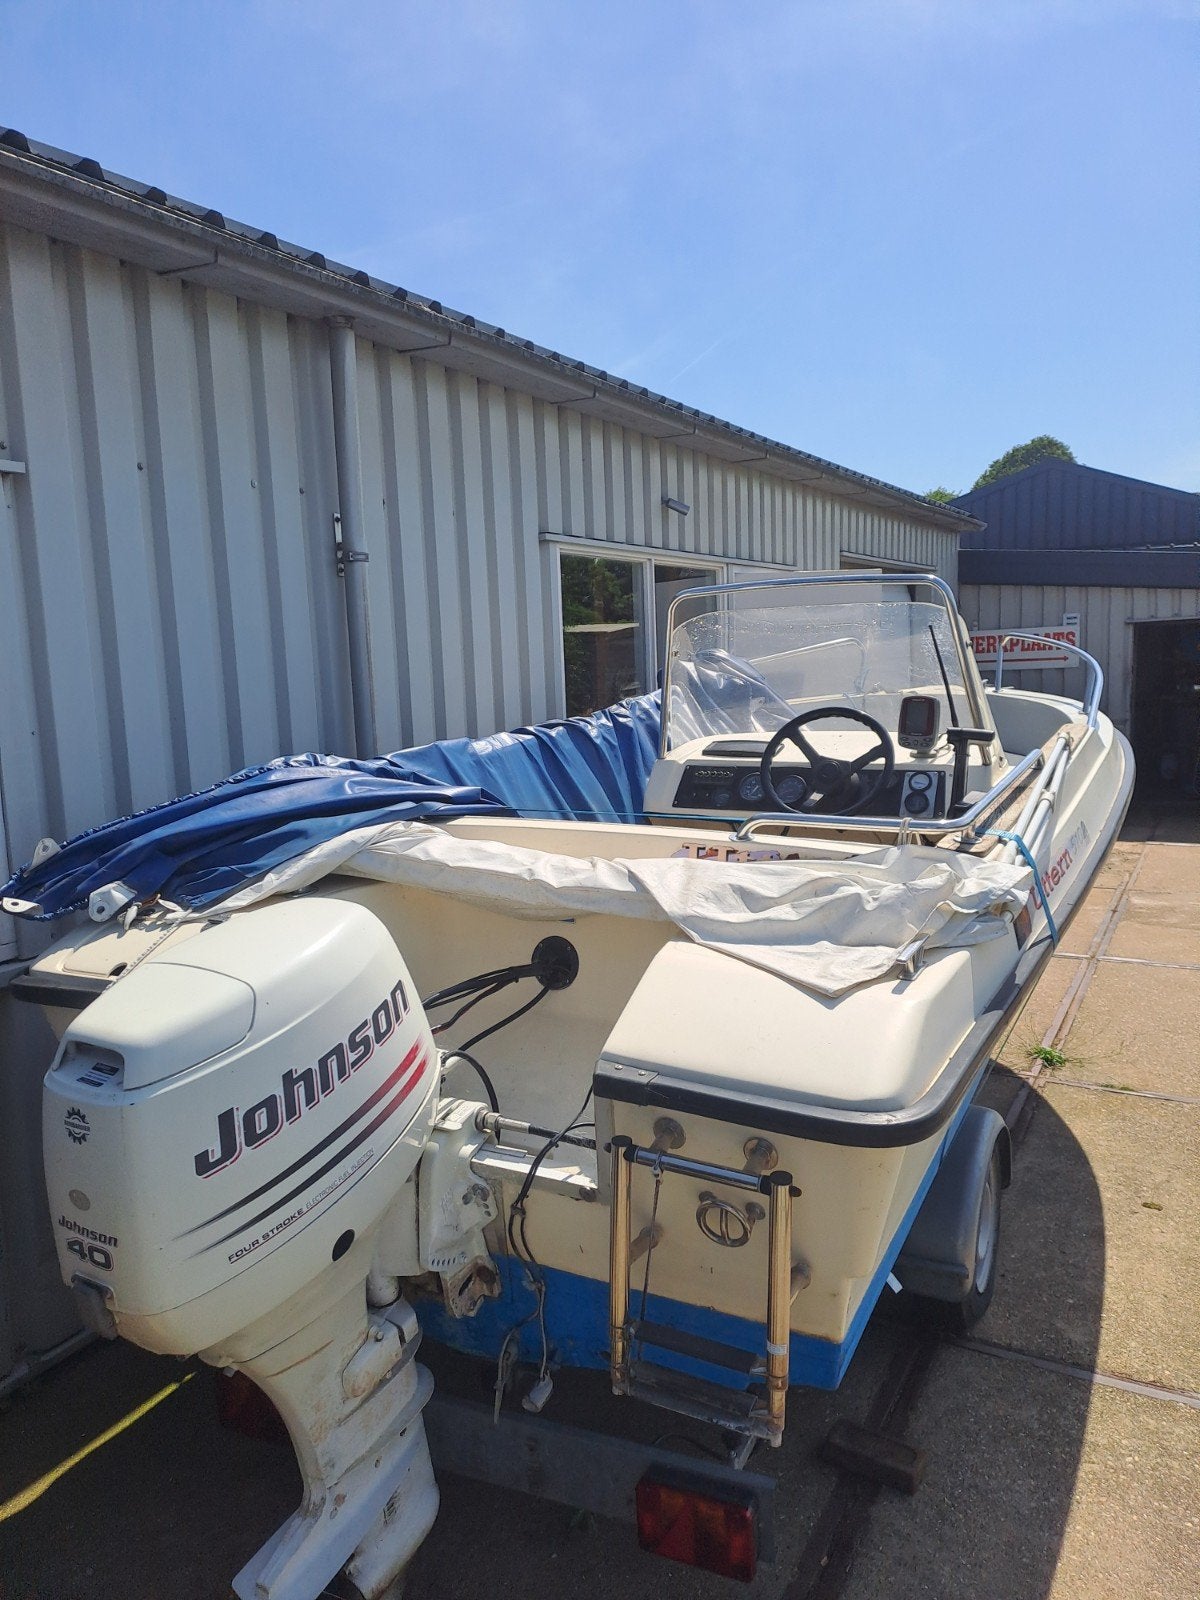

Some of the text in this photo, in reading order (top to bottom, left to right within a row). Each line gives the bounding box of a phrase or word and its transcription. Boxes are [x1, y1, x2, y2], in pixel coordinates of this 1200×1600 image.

[970, 631, 1076, 654] ERKPLAATS
[194, 979, 410, 1179] Johnson
[228, 1239, 260, 1262] FOUR
[262, 1208, 304, 1241] STROKE
[305, 1179, 339, 1209] ELECTRONIC
[350, 1148, 374, 1172] INJECTION
[58, 1215, 118, 1247] Johnson
[66, 1237, 114, 1271] 40
